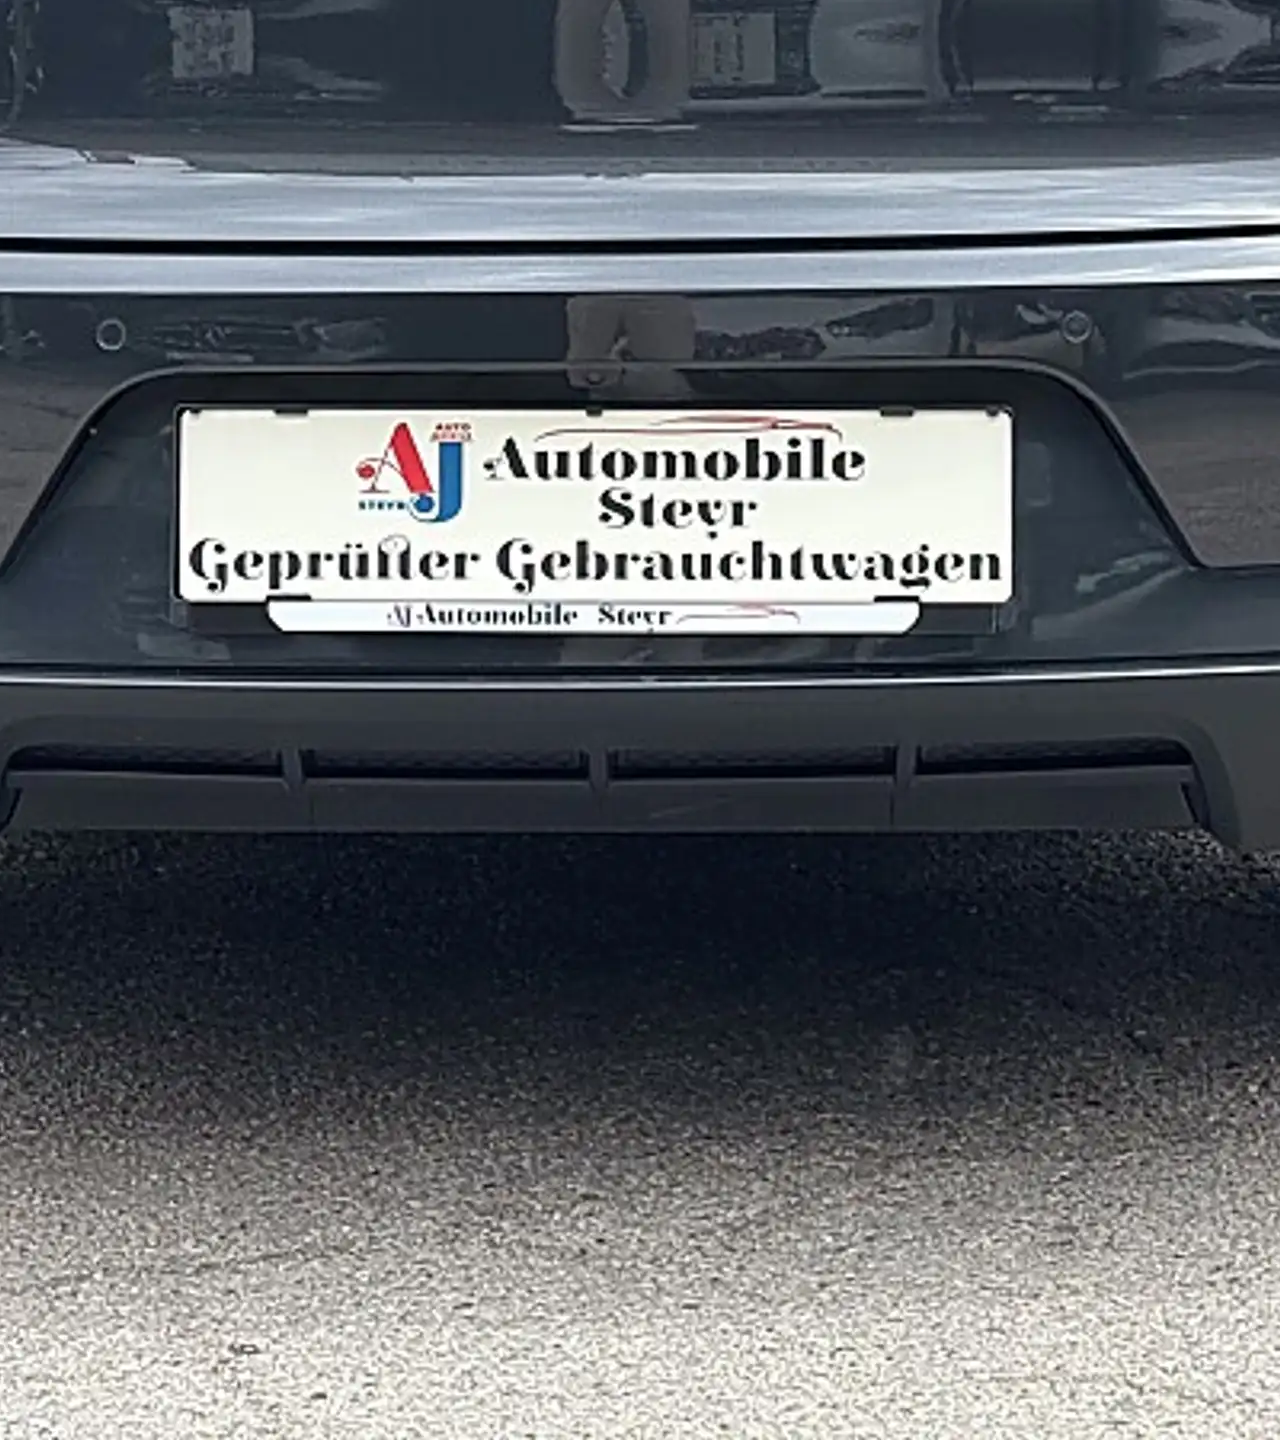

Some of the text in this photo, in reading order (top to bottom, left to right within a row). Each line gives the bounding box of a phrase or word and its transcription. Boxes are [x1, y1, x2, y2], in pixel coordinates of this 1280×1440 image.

[483, 436, 866, 481] Automobile
[598, 486, 758, 540] Steyr
[189, 534, 1002, 594] Geprüfter Gebrauchtwagen
[416, 602, 578, 626] Automobile
[598, 602, 673, 634] Steyr
